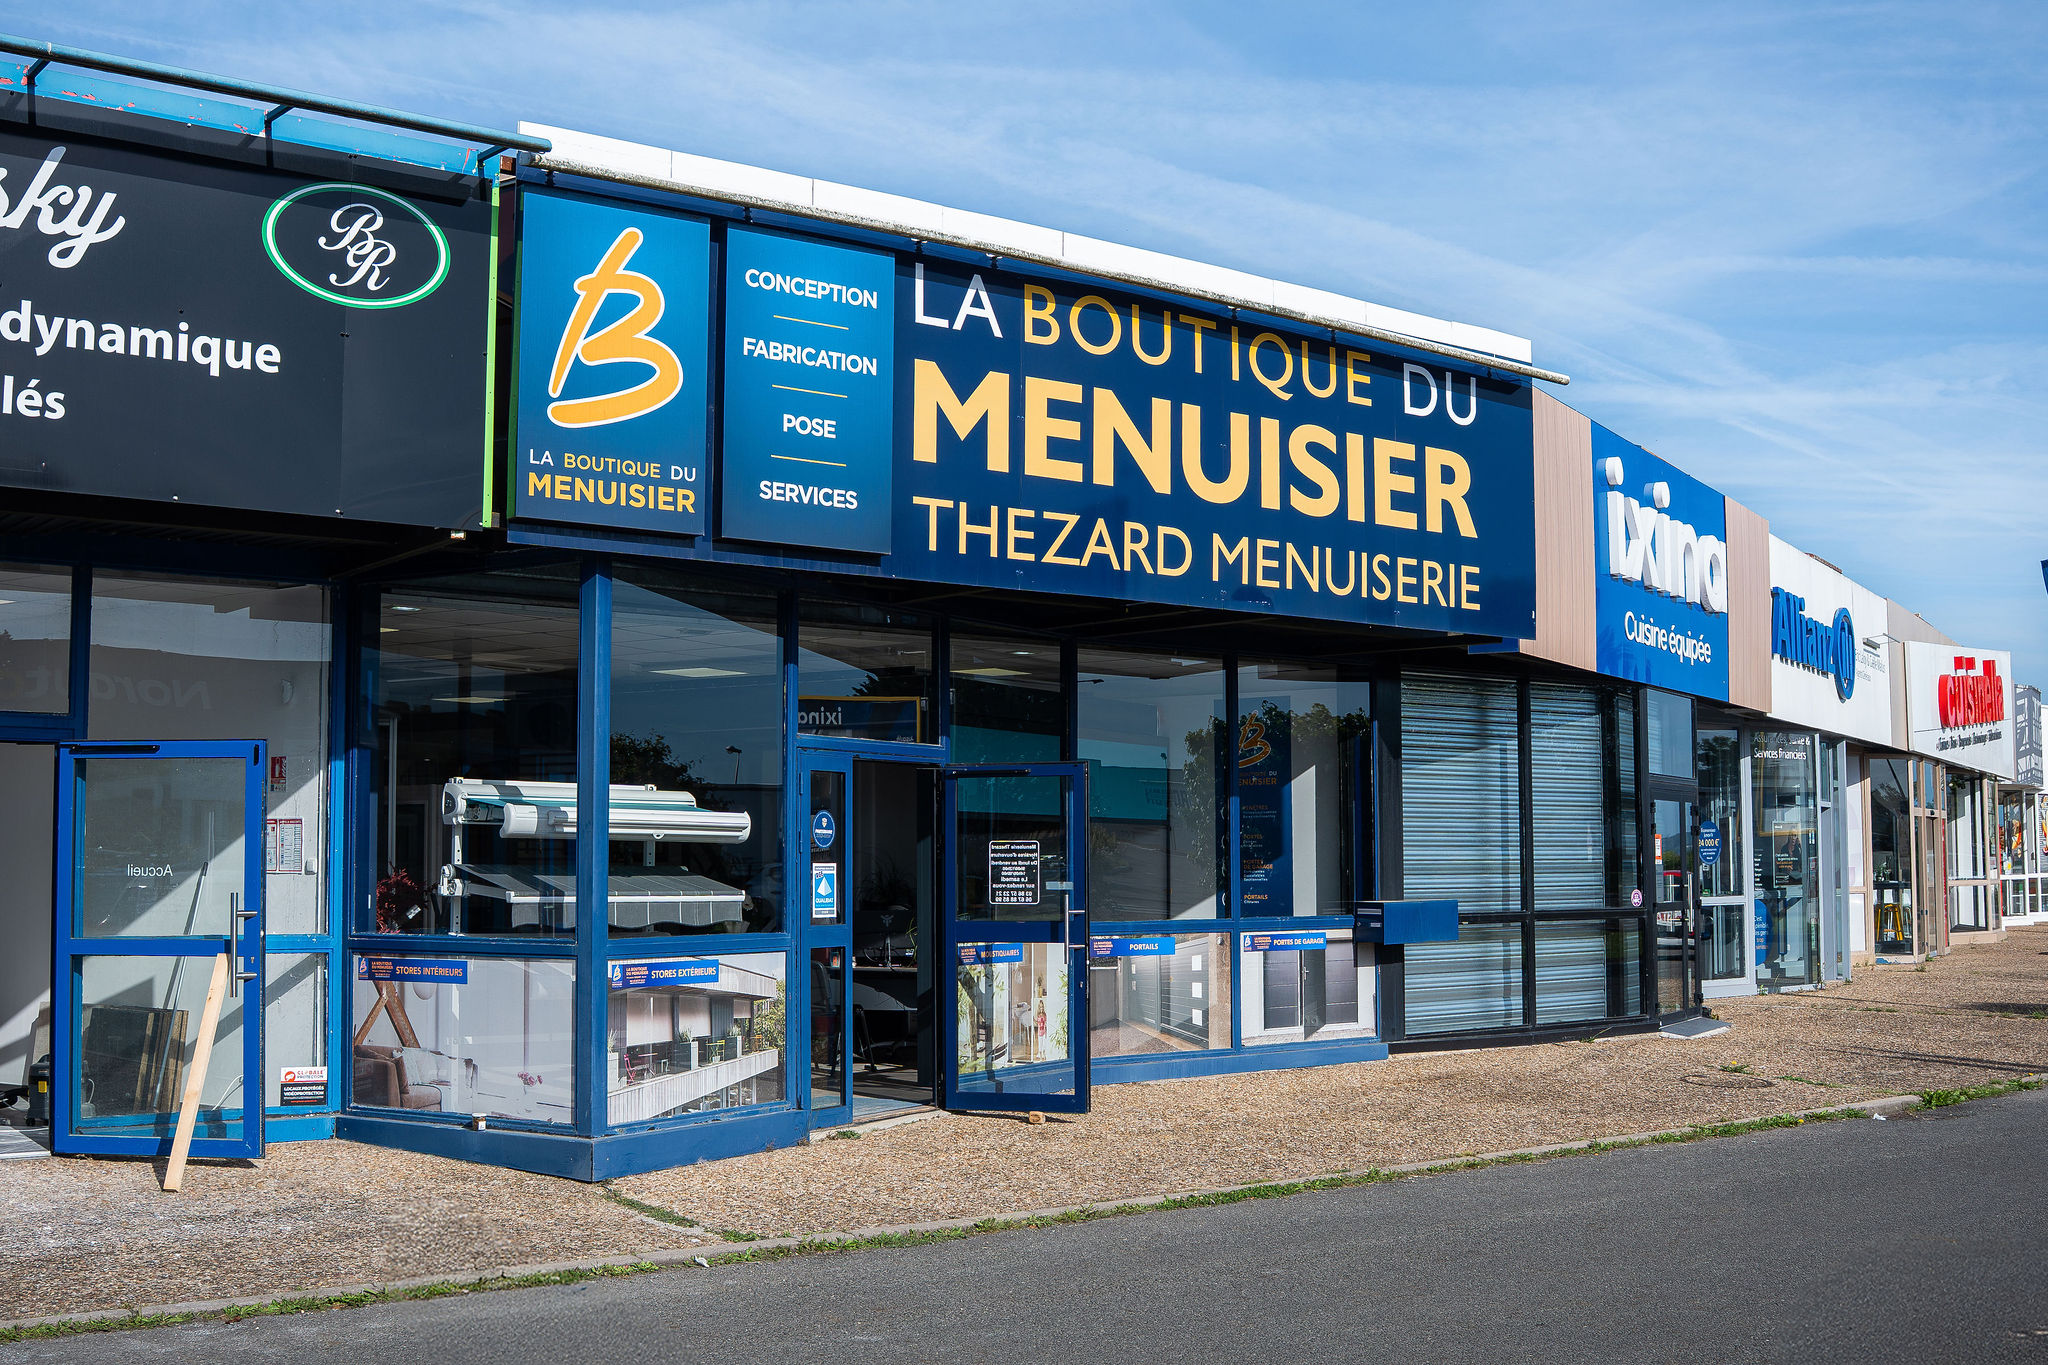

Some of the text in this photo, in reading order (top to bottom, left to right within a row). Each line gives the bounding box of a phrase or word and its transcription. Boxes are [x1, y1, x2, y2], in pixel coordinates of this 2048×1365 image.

[745, 268, 878, 309] CONCEPTION
[0, 299, 281, 377] dynamique
[743, 337, 877, 376] FABRICATION
[914, 262, 1477, 426] LA BOUTIQUE DU
[783, 413, 836, 439] POSE
[529, 449, 696, 482] LA BOUTIQUE DU
[913, 358, 1478, 538] MENUISIER
[528, 472, 696, 514] MENUISIER
[759, 480, 858, 510] SERVICES
[912, 496, 1481, 612] THEZARD MENUISERIE
[1606, 456, 1728, 613] ixina
[1624, 611, 1711, 665] Cuisine équipée
[1771, 586, 1836, 676] Allianz
[1754, 748, 1806, 760] Services financiers
[1239, 777, 1277, 786] ENUISIER
[395, 966, 421, 975] STORES
[423, 966, 463, 977] INTÉRIEURS
[651, 967, 716, 979] STORES EXTÉRIEURS
[981, 949, 1020, 958] MOUSTIQUAIRES
